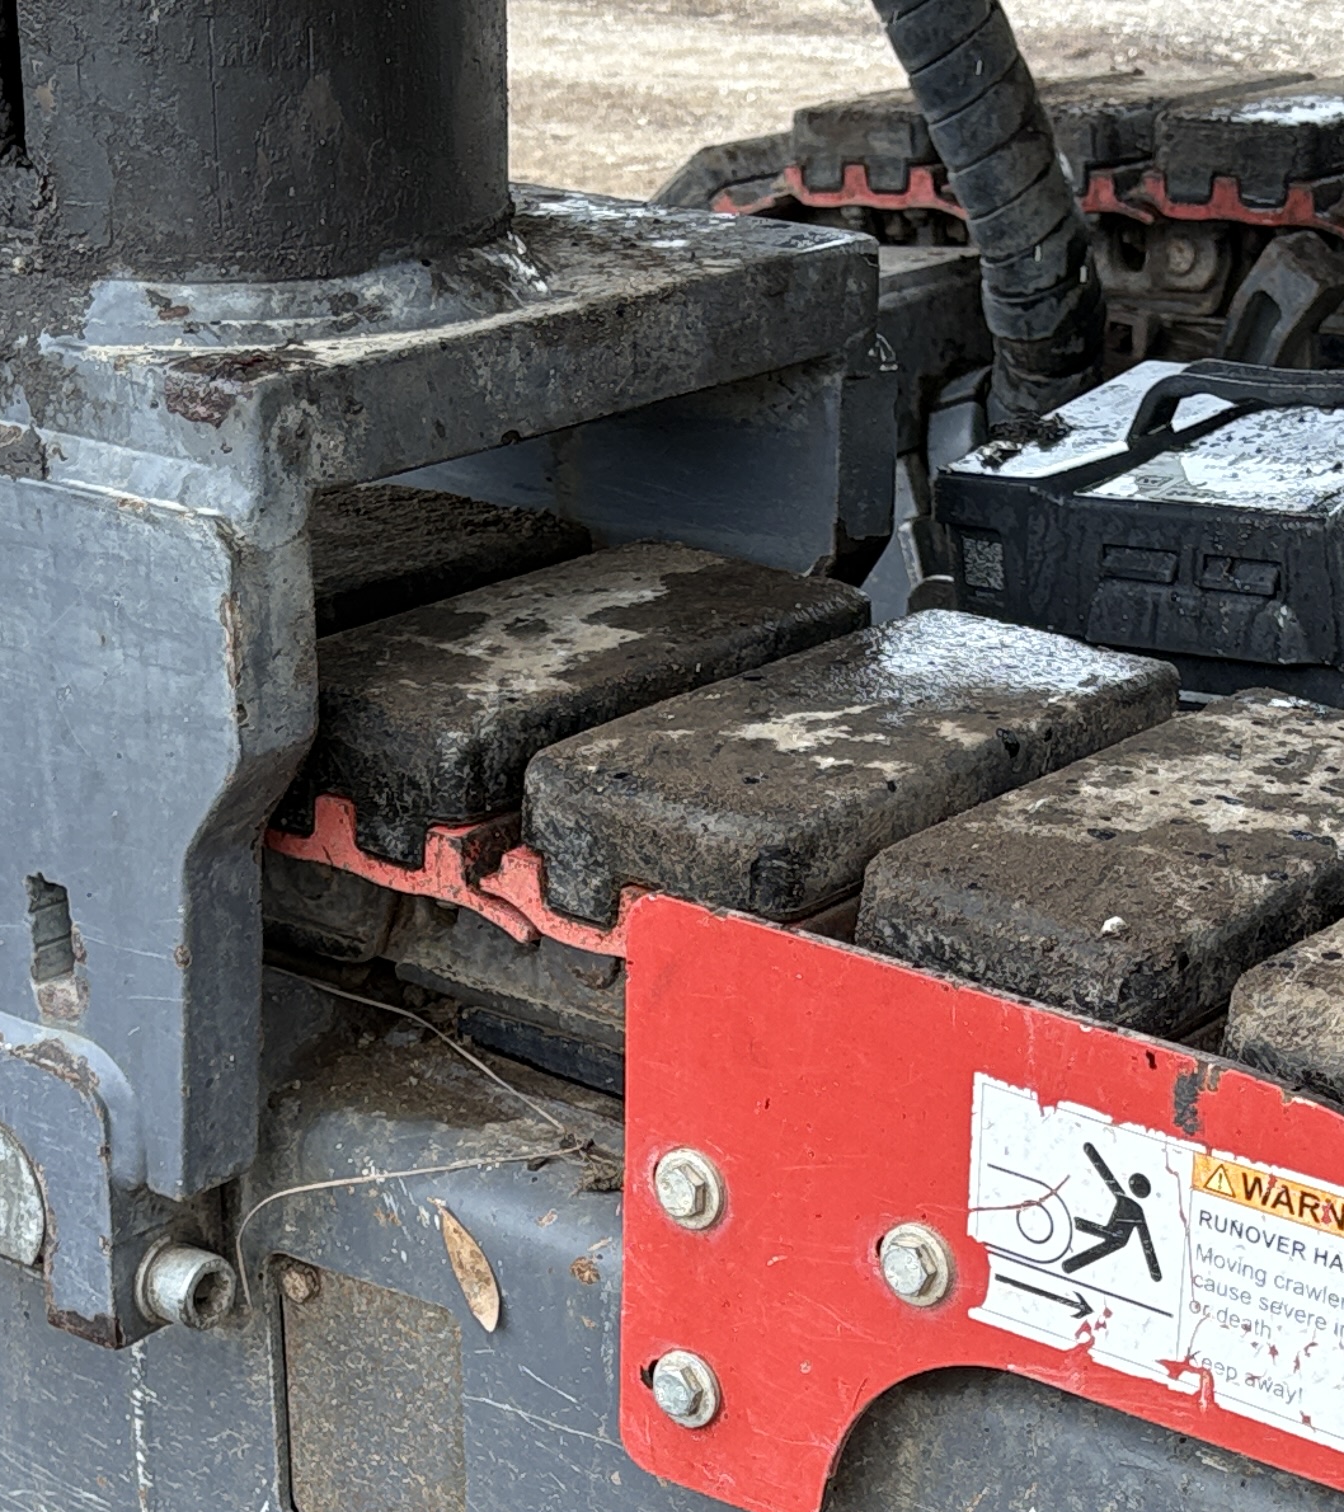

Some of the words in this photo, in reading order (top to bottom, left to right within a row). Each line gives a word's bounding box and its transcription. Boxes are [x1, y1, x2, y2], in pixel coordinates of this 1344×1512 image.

[1198, 1209, 1306, 1261] RUNOVER
[1195, 1244, 1267, 1288] Moving
[1189, 1299, 1211, 1318] or
[1216, 1307, 1272, 1340] death
[1192, 1273, 1252, 1301] cause
[1258, 1297, 1328, 1331] severe
[1185, 1347, 1238, 1381] Keep
[1244, 1371, 1304, 1405] away!
